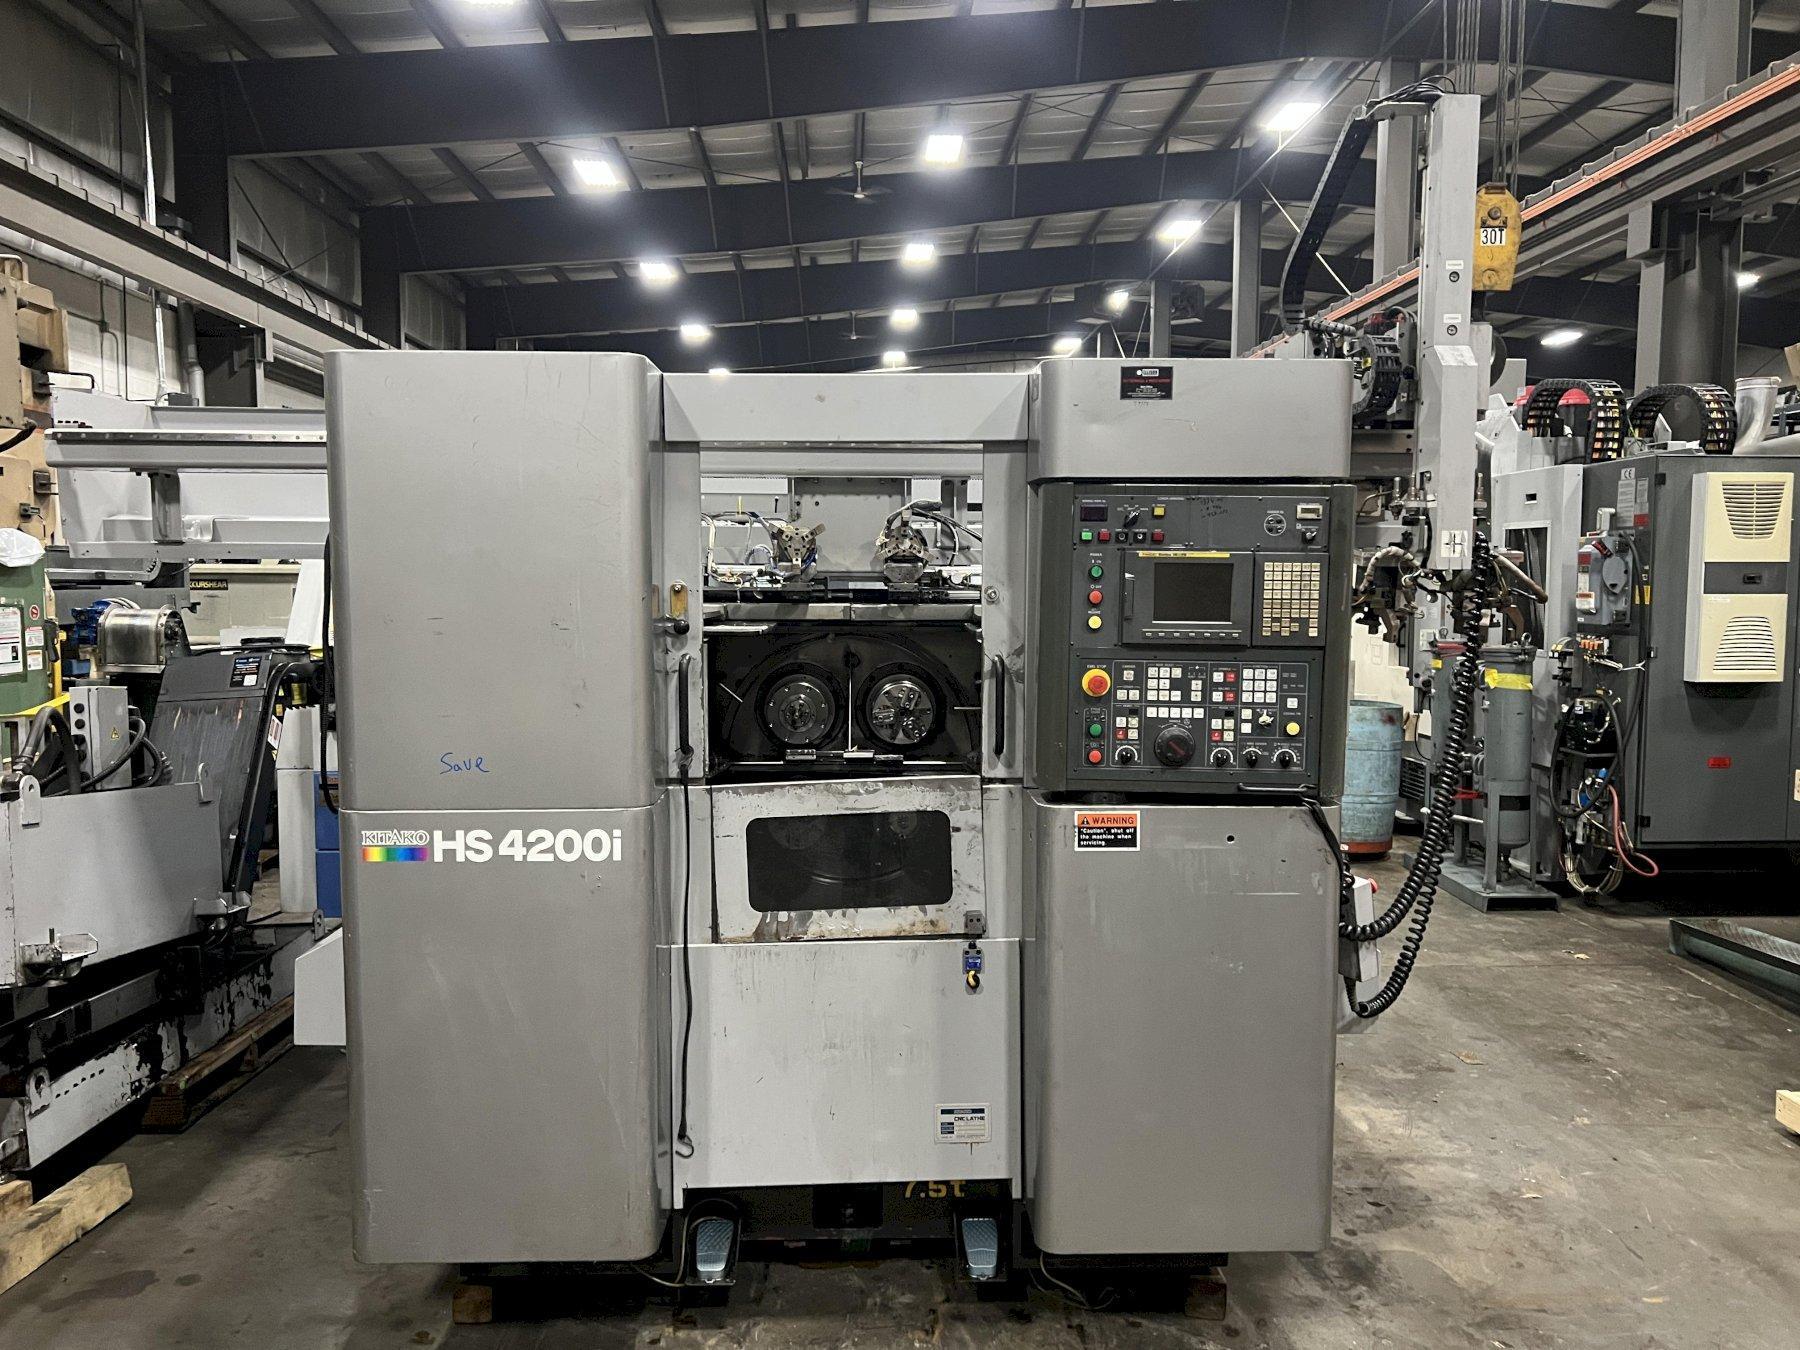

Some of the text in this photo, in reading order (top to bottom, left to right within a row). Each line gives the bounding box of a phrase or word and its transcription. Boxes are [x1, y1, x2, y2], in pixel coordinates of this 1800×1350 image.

[1481, 228, 1505, 245] 30T
[440, 752, 490, 774] Save
[1092, 816, 1135, 825] WARNING
[361, 828, 622, 862] KITAKO HS 4200i
